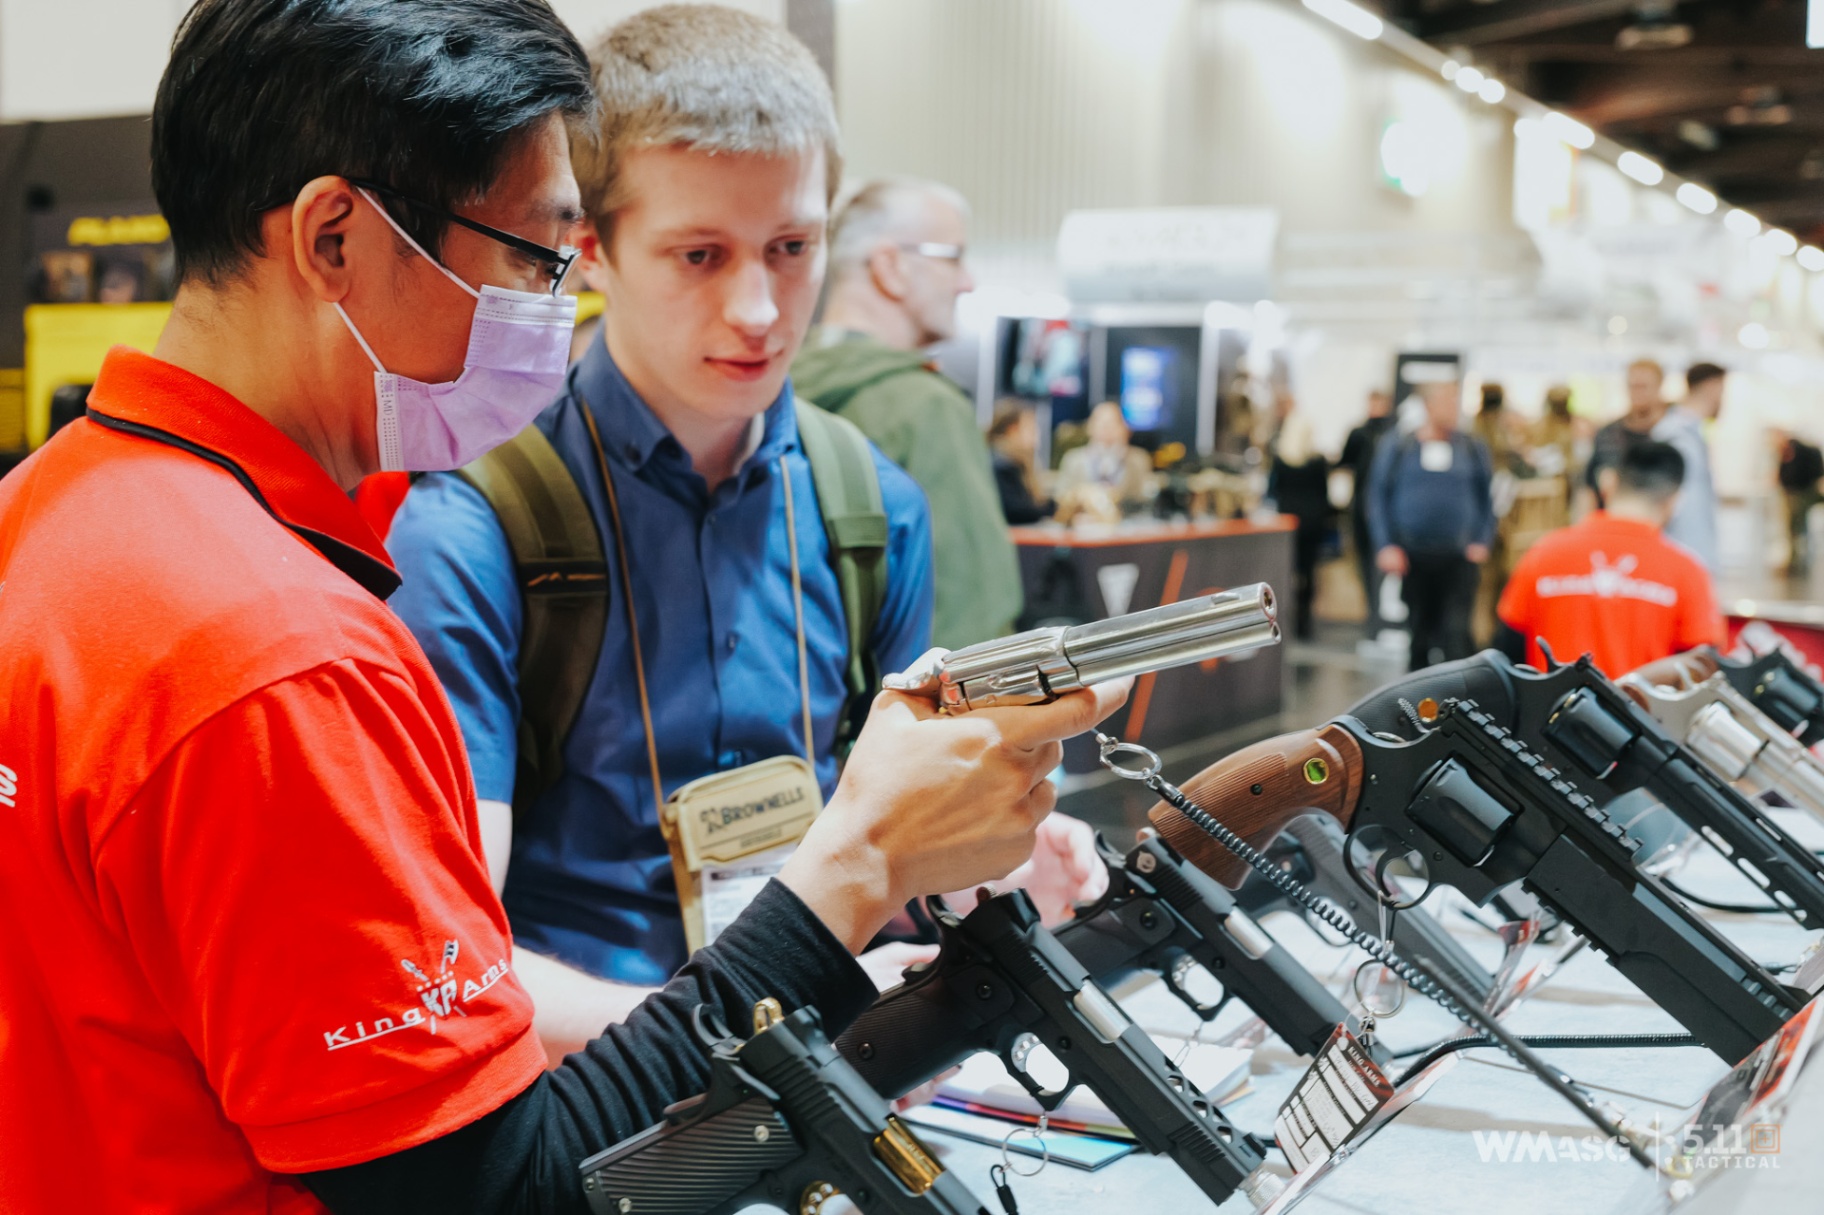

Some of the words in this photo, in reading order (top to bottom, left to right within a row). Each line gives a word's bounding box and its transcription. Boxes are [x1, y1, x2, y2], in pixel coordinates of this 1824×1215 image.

[721, 787, 804, 825] BROWNELLS
[323, 1007, 424, 1047] King
[463, 958, 508, 999] Arms
[1347, 1046, 1365, 1066] KING
[1363, 1065, 1381, 1088] ARMS
